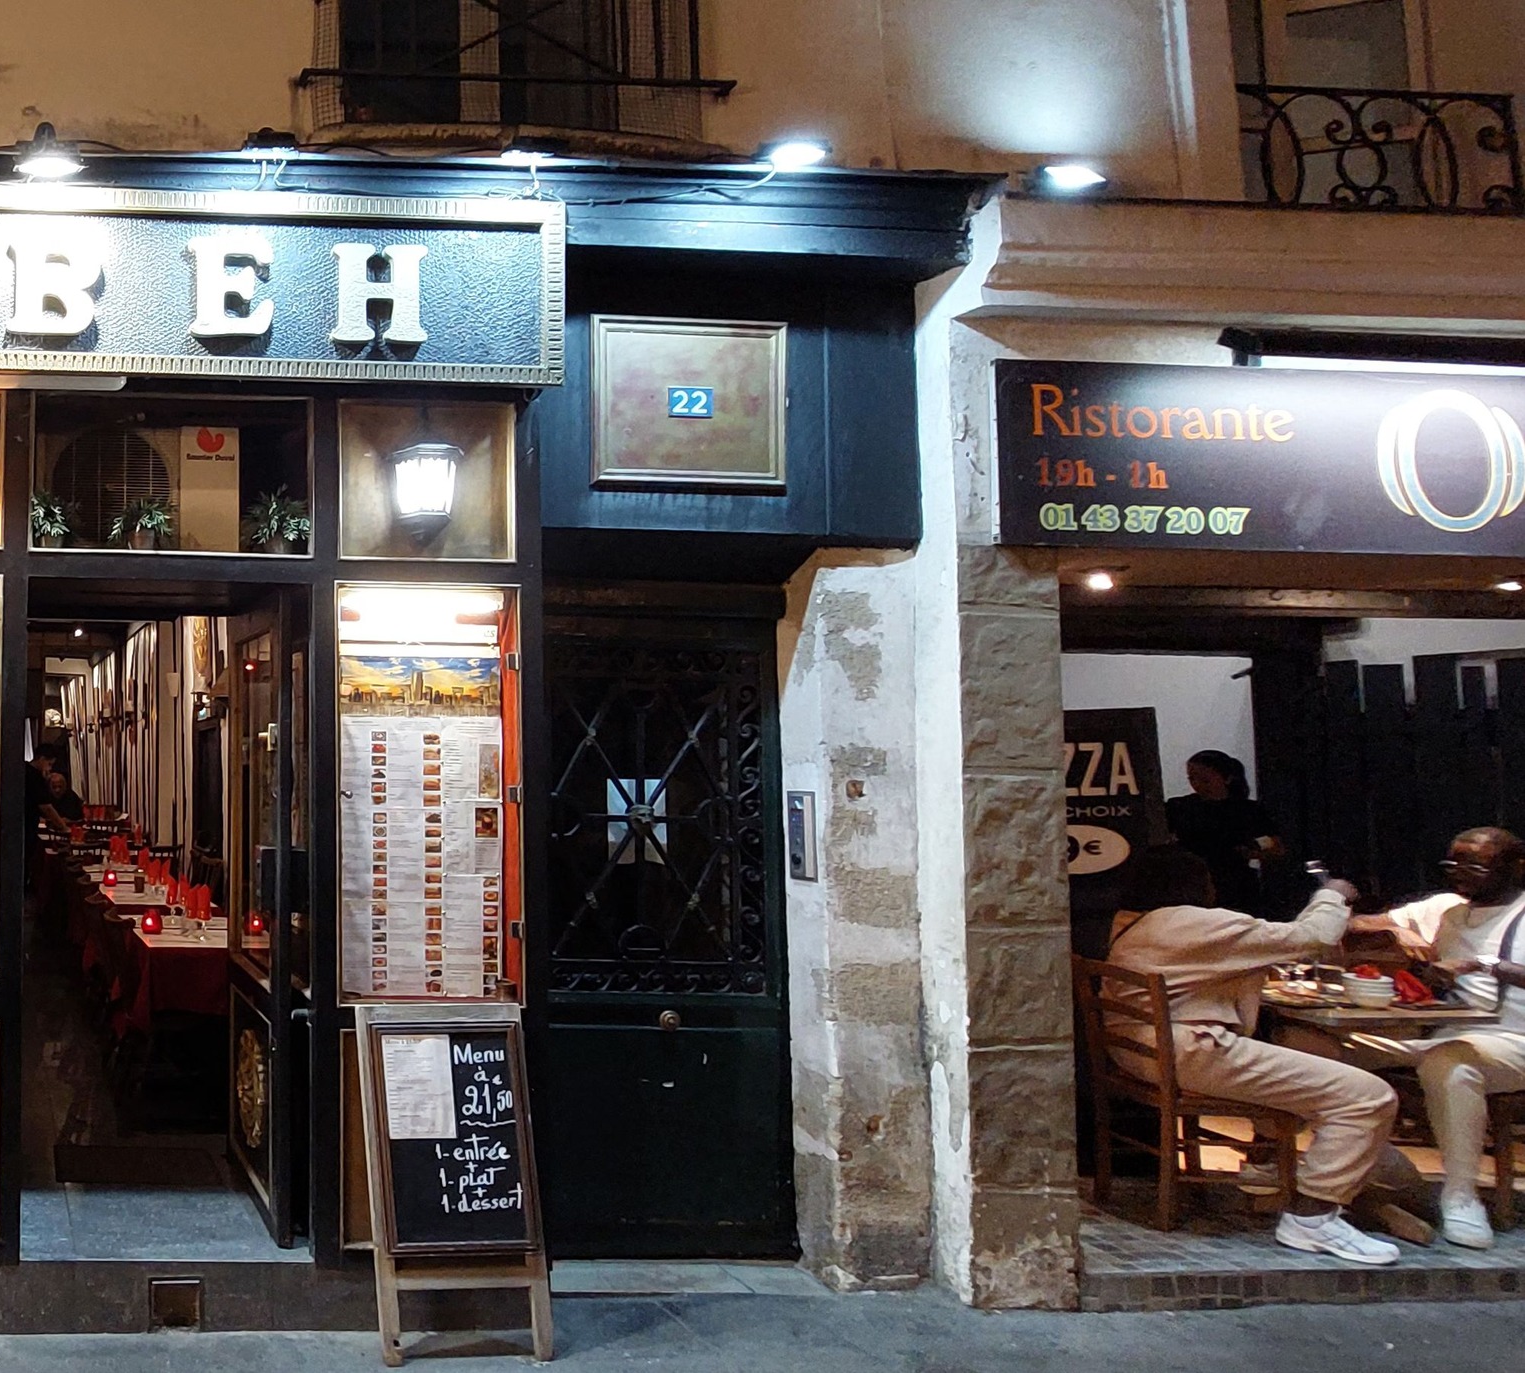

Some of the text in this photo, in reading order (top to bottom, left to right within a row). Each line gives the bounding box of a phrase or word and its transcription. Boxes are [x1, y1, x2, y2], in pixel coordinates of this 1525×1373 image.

[671, 390, 709, 415] 22
[1030, 383, 1296, 442] Ristorante
[1035, 455, 1097, 488] 19h
[1039, 502, 1252, 536] 01 43 37 20 07
[453, 1042, 505, 1065] Menu
[473, 1065, 490, 1082] à
[461, 1083, 513, 1122] 21,50
